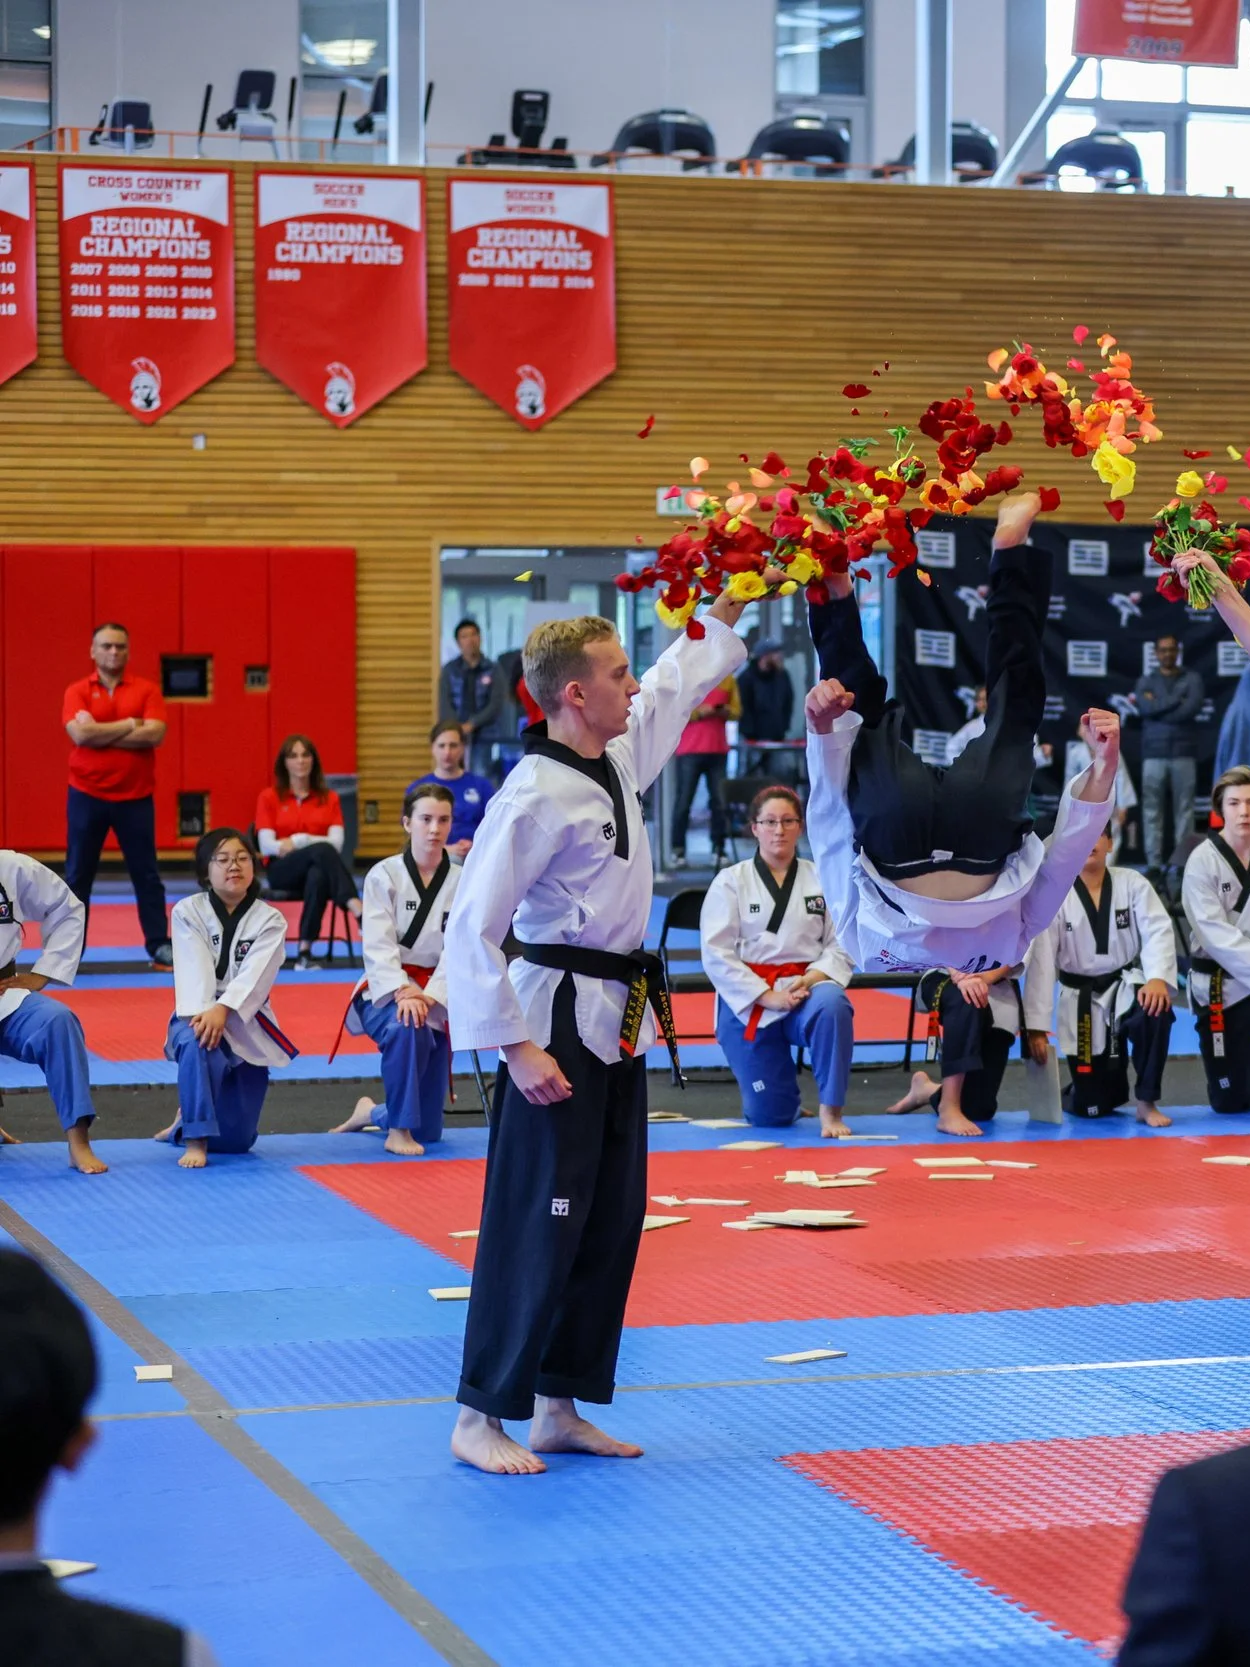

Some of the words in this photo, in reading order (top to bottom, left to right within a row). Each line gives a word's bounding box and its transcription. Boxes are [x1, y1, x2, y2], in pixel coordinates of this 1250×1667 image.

[1124, 35, 1184, 59] 2009
[88, 176, 133, 188] CROSS
[137, 177, 202, 190] COUNTRY
[313, 183, 365, 196] SOCCER
[120, 192, 173, 202] WOMEN'S
[323, 198, 357, 208] MEN'S
[505, 190, 555, 201] SOCCER
[505, 204, 556, 214] WOMEN'S
[90, 216, 201, 239] REGIONAL
[285, 221, 394, 244] REGIONAL
[476, 227, 583, 250] REGIONAL
[80, 237, 211, 260] CHAMPIONS
[275, 242, 404, 265] CHAMPIONS
[467, 247, 593, 271] CHAMPIONS
[70, 263, 103, 276] 2007
[70, 284, 102, 297] 2011
[108, 285, 140, 298] 2012
[145, 285, 178, 298] 2013
[181, 287, 213, 300] 2014
